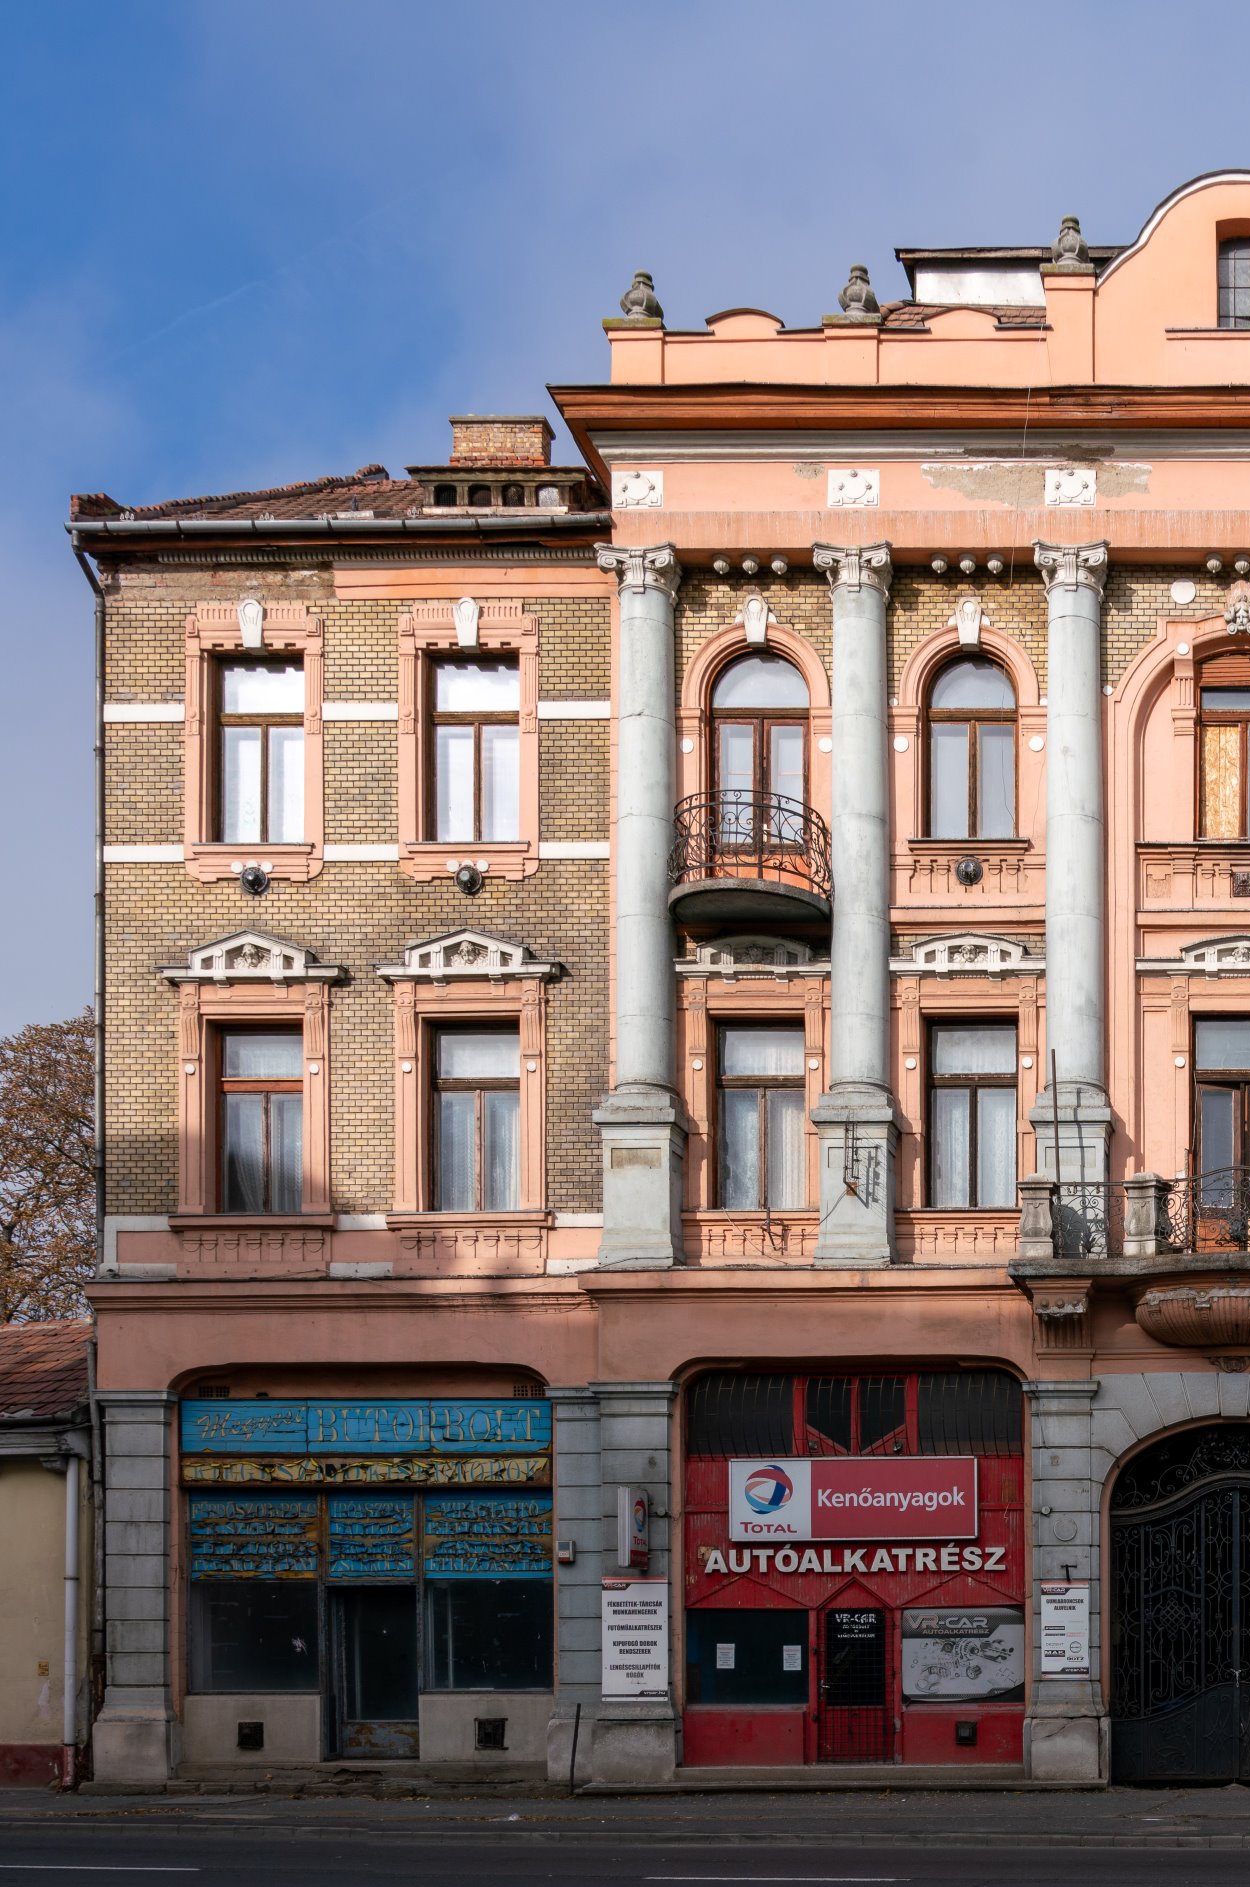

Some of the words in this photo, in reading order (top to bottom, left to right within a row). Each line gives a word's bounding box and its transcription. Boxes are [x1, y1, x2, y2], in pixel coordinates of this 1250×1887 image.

[817, 1486, 966, 1512] Kenőanyagok
[704, 1543, 1006, 1574] AUTÓALKATRÉSZ
[907, 1613, 989, 1630] VR-CAR
